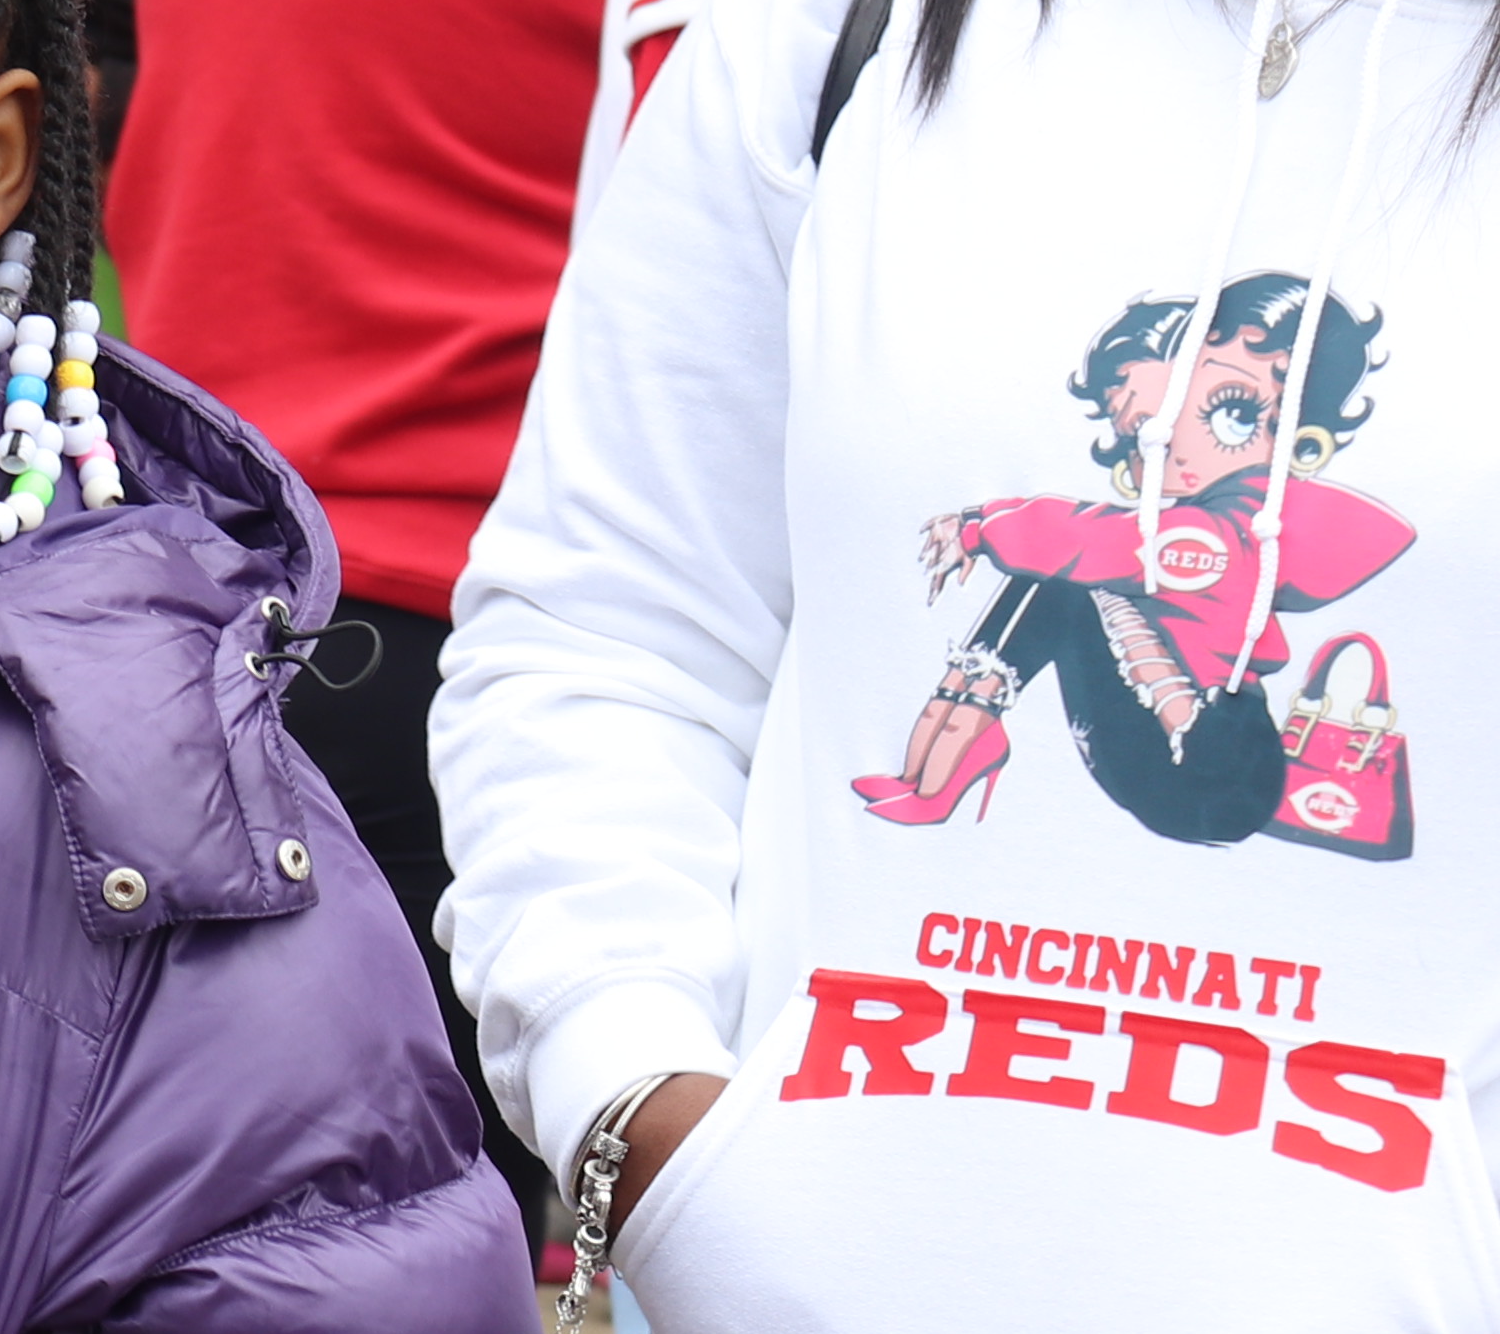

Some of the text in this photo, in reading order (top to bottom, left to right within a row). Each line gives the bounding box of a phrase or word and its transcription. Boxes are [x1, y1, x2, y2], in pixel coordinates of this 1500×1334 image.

[1160, 548, 1229, 572] REDS
[916, 912, 1322, 1022] CINCINNATI
[779, 967, 1446, 1193] REDS
